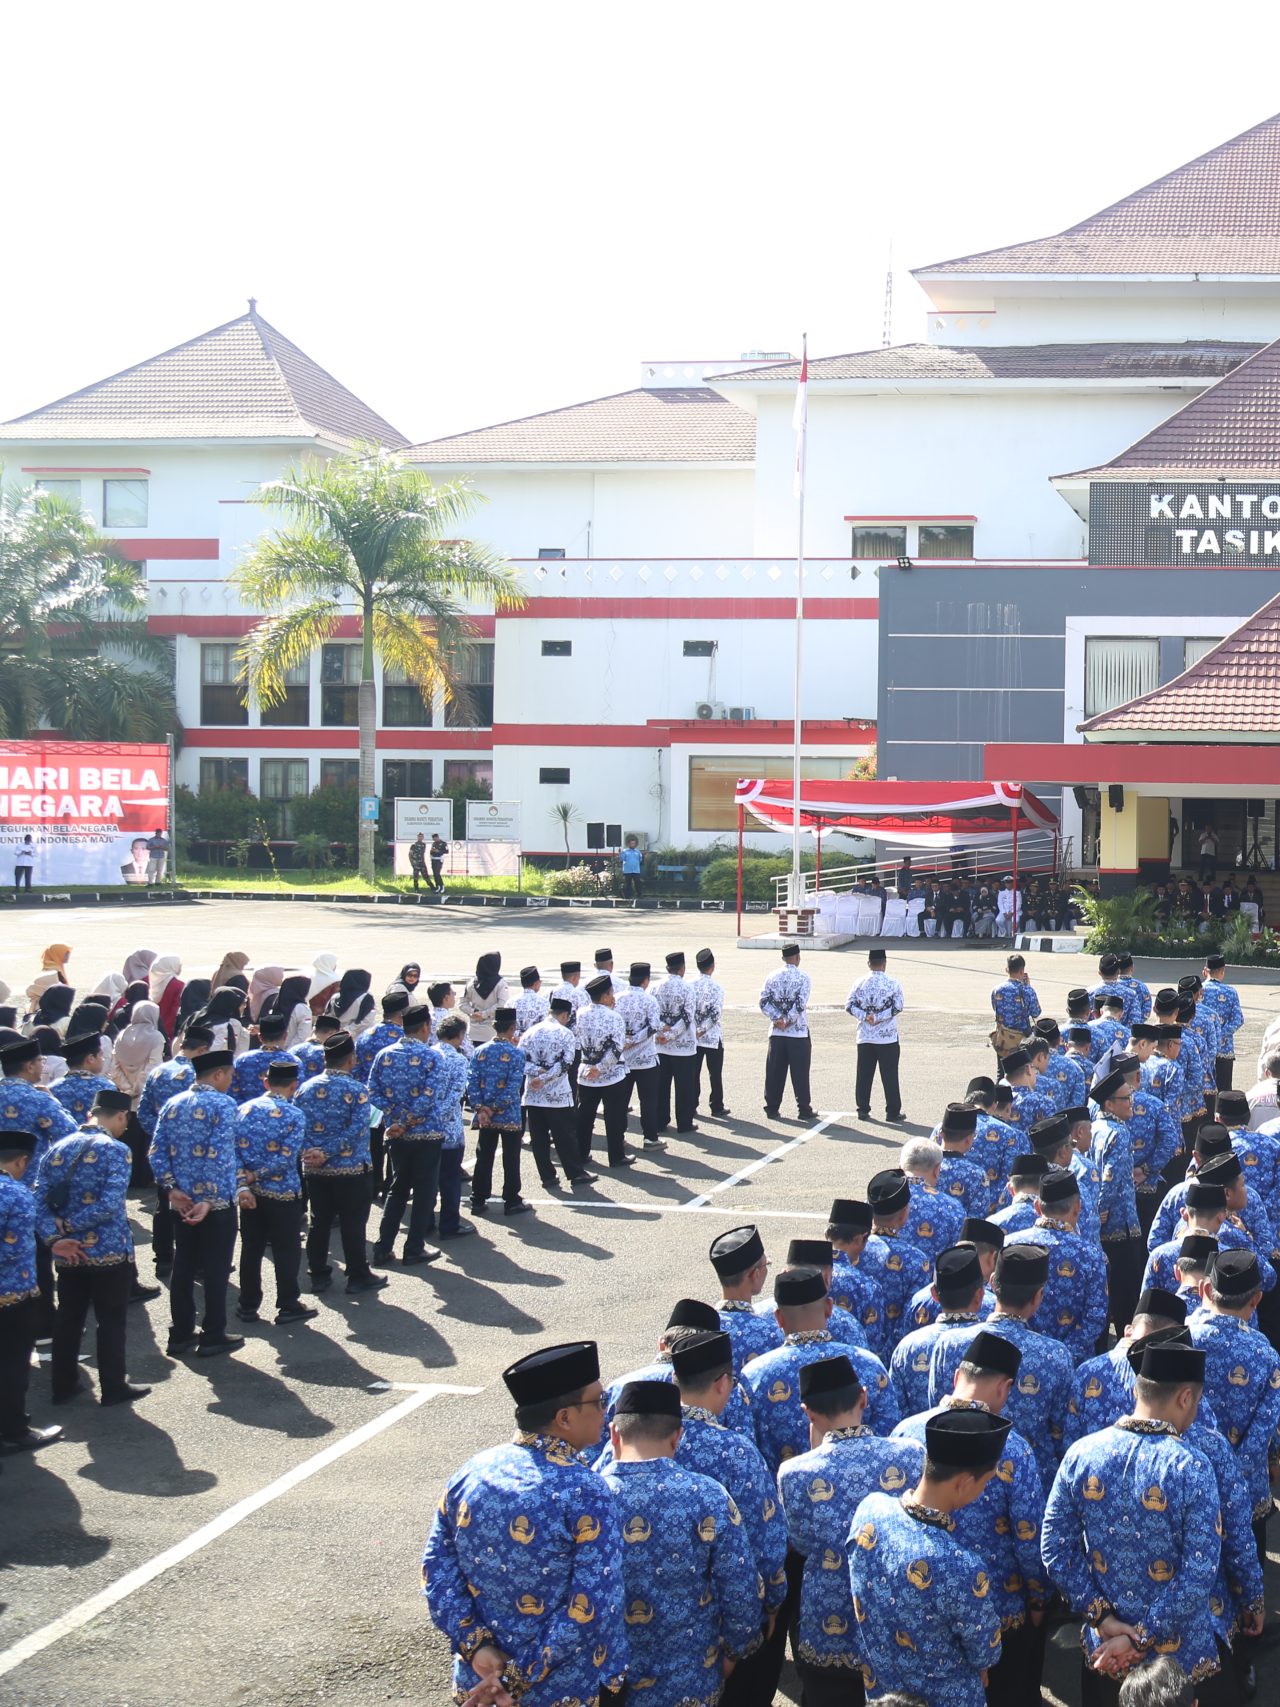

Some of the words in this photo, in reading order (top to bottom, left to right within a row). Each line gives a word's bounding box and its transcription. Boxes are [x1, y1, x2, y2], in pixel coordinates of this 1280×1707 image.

[79, 768, 161, 792] BELA
[364, 801, 376, 817] P
[0, 824, 51, 833] EGUHKAN
[53, 824, 78, 833] BELA
[80, 824, 119, 833] NEGARA
